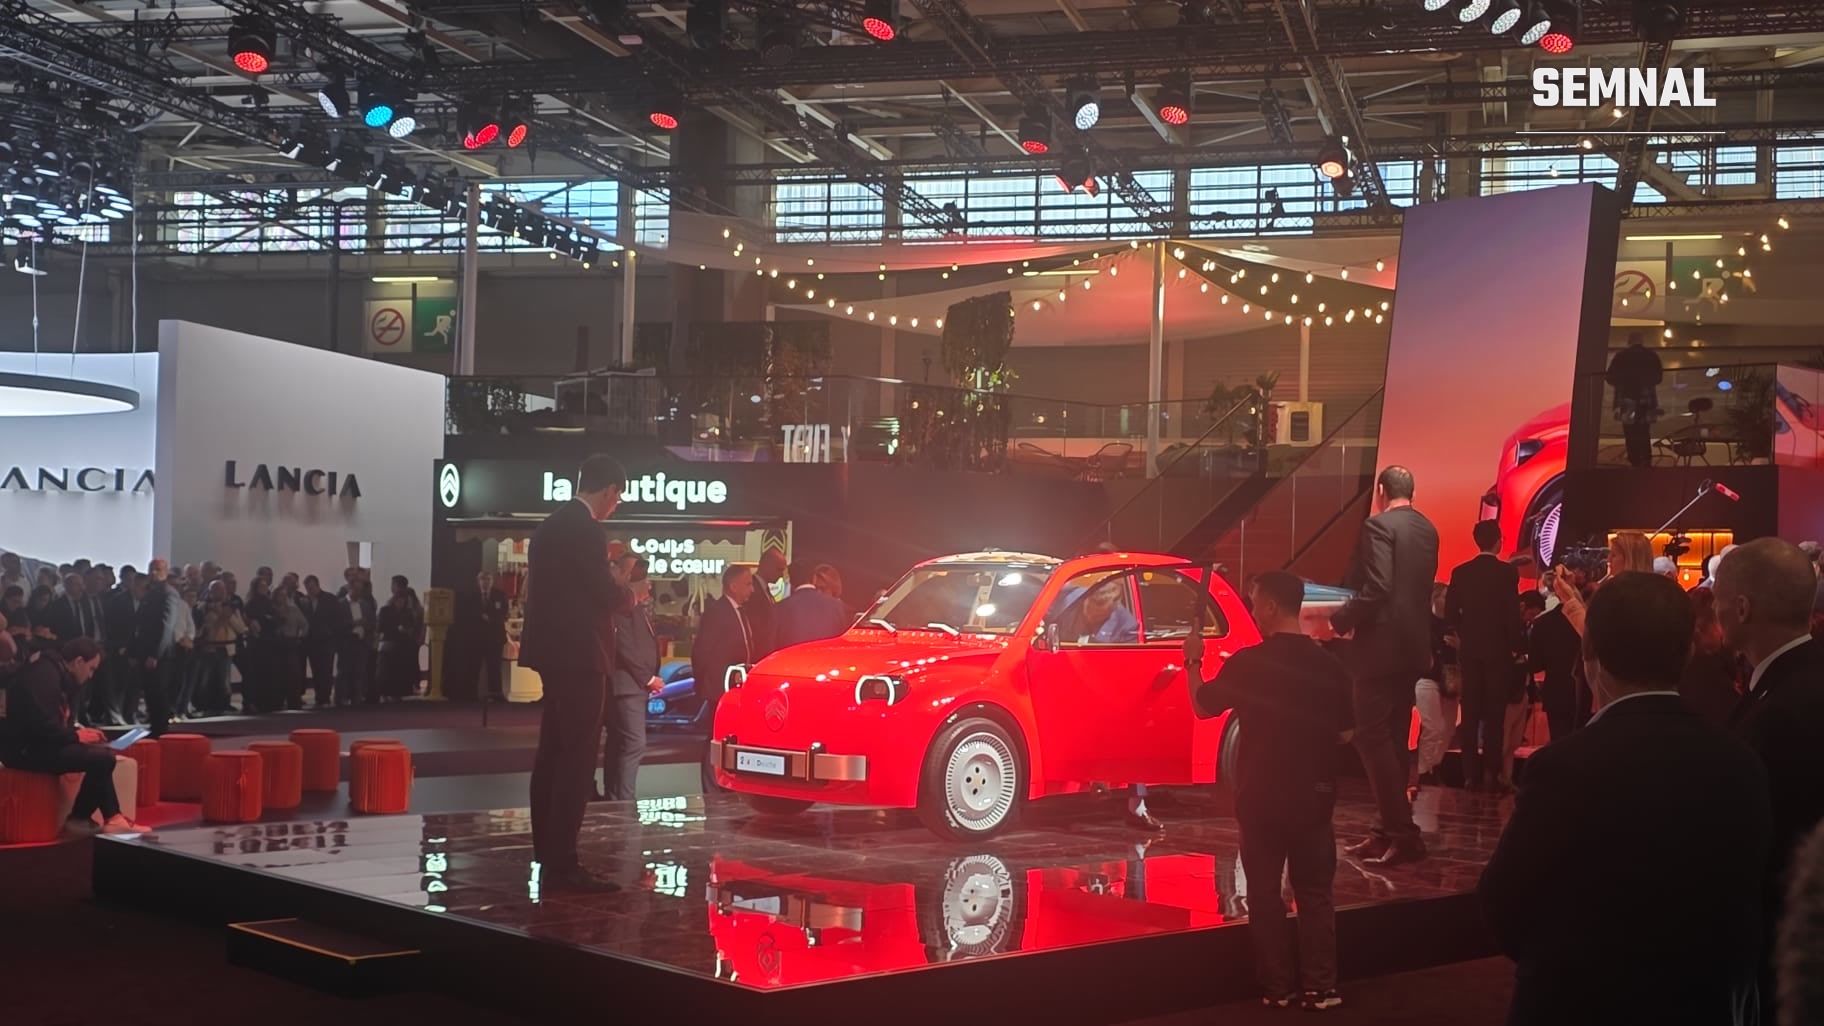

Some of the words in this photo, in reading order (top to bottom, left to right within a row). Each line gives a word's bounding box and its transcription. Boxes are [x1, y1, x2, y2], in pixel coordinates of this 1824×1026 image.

[225, 460, 361, 498] LANCIA
[543, 472, 572, 501] la
[577, 472, 727, 510] utique
